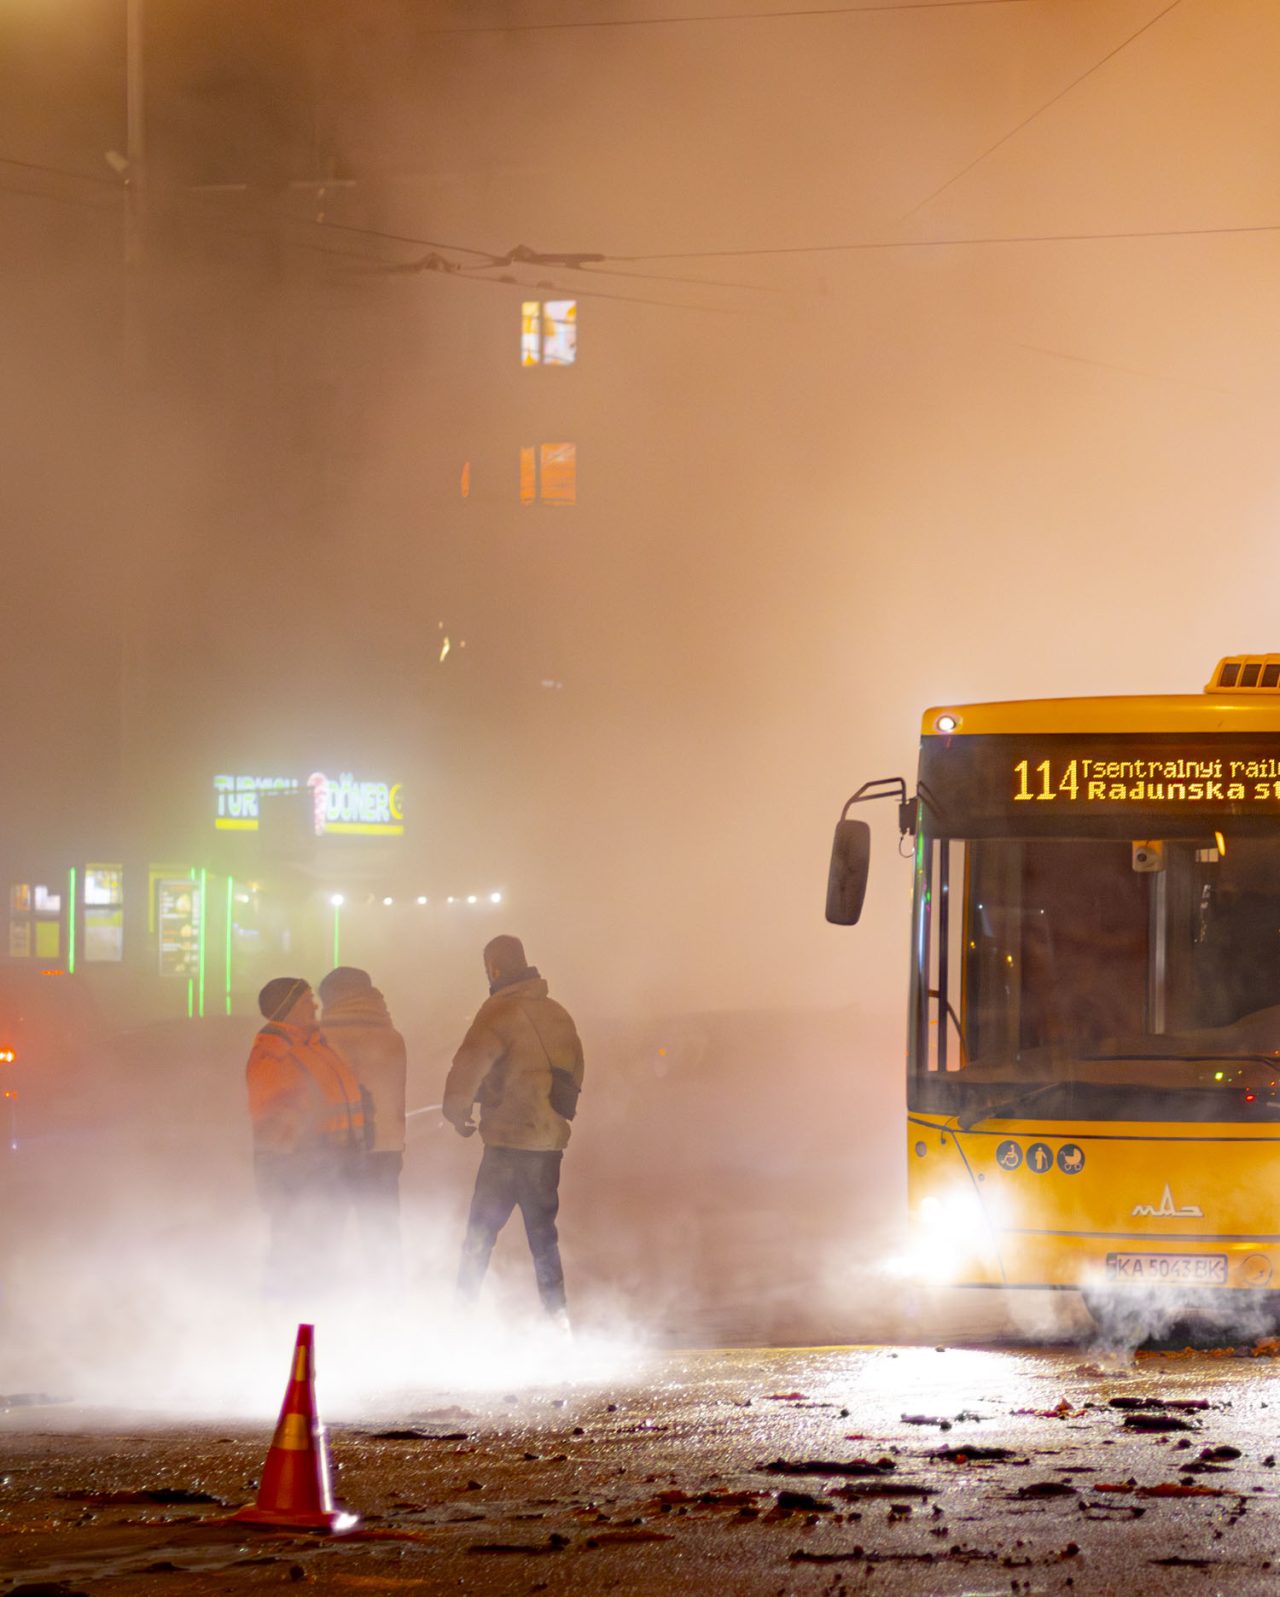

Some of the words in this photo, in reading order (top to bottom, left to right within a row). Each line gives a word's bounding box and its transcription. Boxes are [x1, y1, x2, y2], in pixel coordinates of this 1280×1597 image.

[1013, 760, 1080, 800] 114
[1081, 759, 1222, 778] Tsentralnyi
[326, 772, 391, 822] DÖNER
[1087, 780, 1246, 800] Radunska
